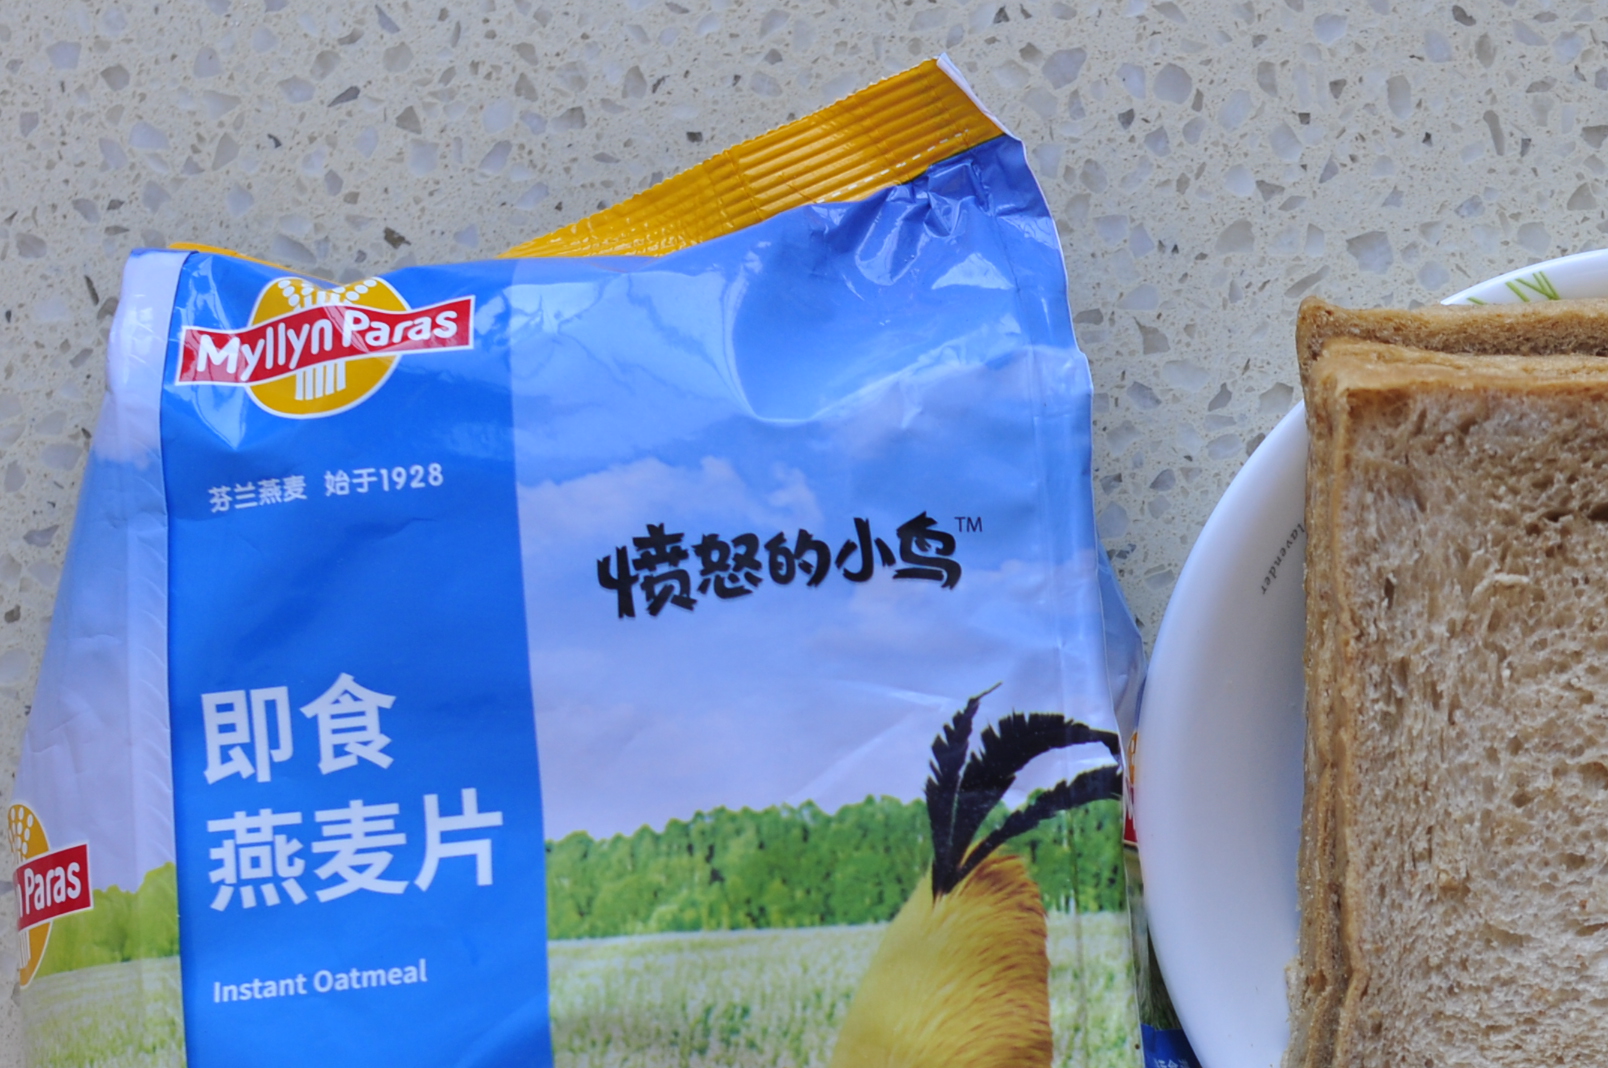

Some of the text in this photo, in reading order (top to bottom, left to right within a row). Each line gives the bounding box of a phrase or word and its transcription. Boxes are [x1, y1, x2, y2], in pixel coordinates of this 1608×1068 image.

[197, 307, 458, 382] Myllyn Paras
[208, 462, 444, 514] 芬兰燕麦 始于1928
[596, 511, 962, 619] 愤怒的小鸟
[200, 672, 398, 785] 即食
[206, 787, 503, 912] 燕麦片
[24, 862, 82, 915] Paras
[213, 959, 427, 1003] Instant Oatmeal
